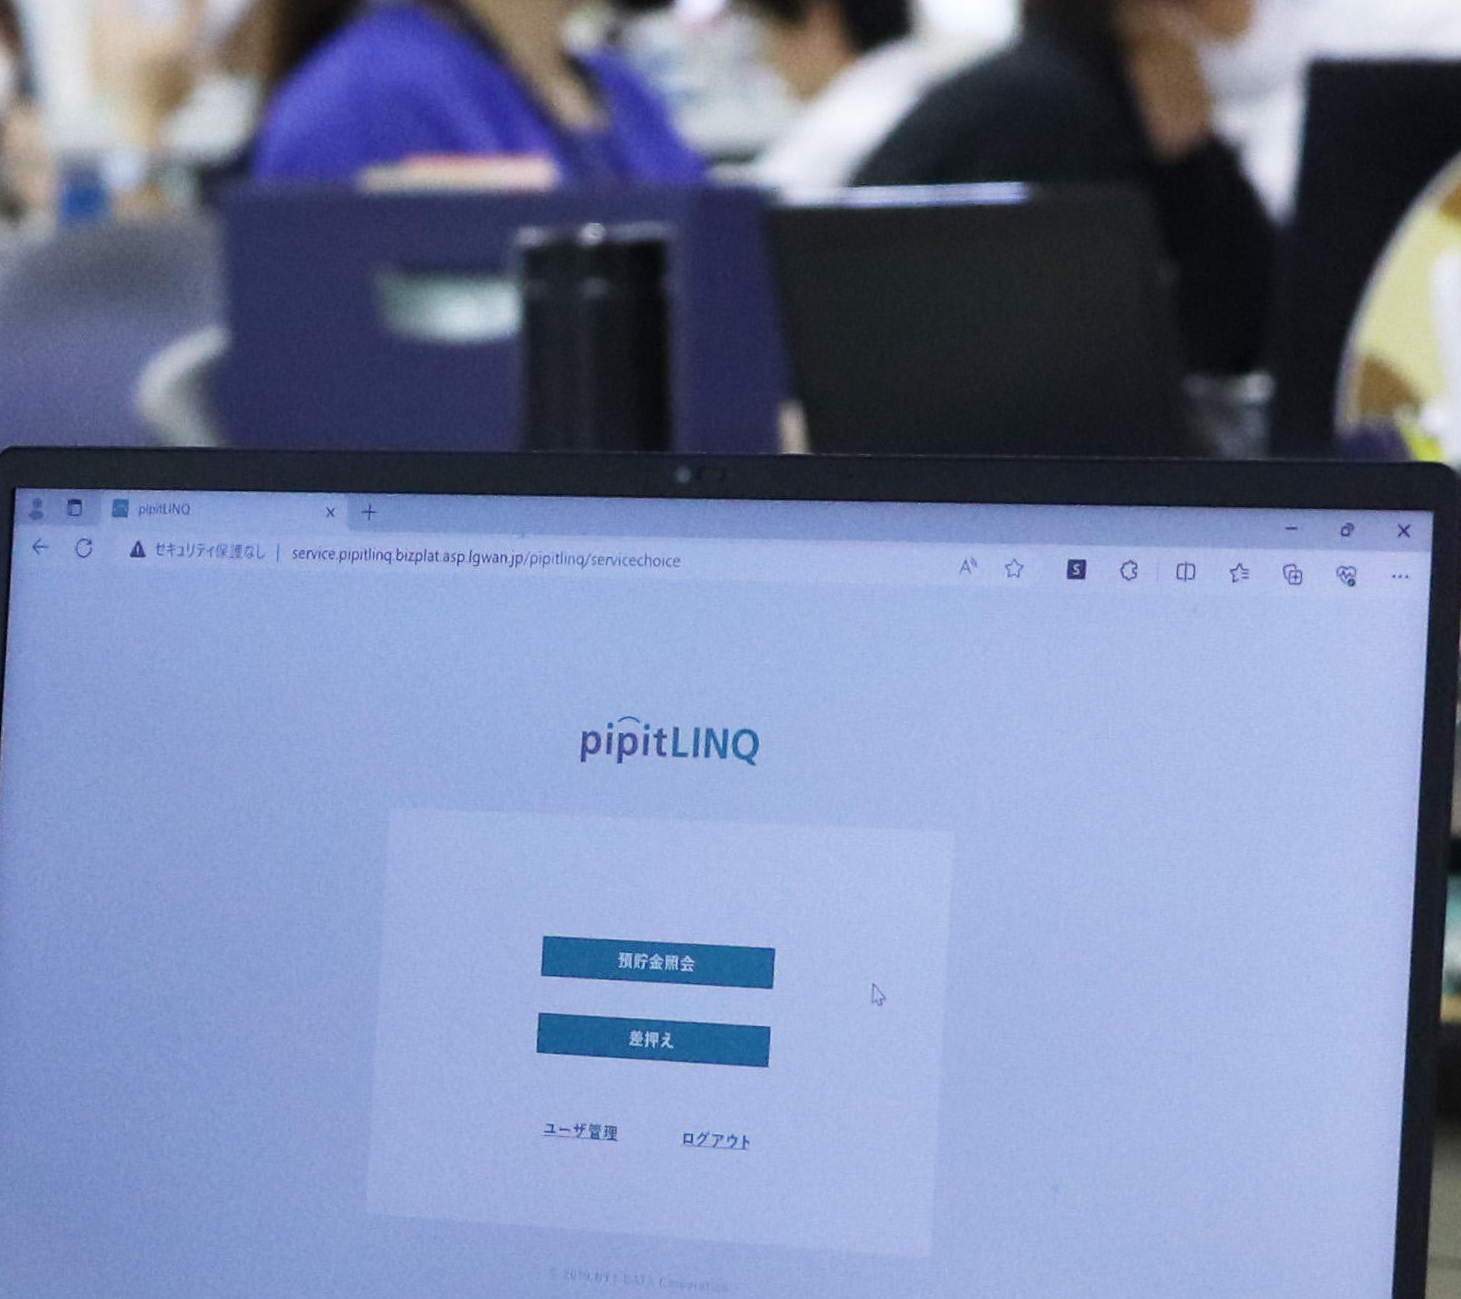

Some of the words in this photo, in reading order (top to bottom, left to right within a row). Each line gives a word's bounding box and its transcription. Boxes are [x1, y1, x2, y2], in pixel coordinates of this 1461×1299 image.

[154, 542, 266, 560] セキュリティ保護なし
[291, 546, 682, 569] service.pipitlinq.bizplat.asp.lgwan.jp/pipitlinq/servicechoice
[580, 718, 760, 766] pipitLINQ
[617, 951, 696, 972] 預貯金照会
[628, 1029, 675, 1049] 差押え
[543, 1123, 618, 1141] ユーザ管理
[682, 1131, 751, 1150] ログアウト
